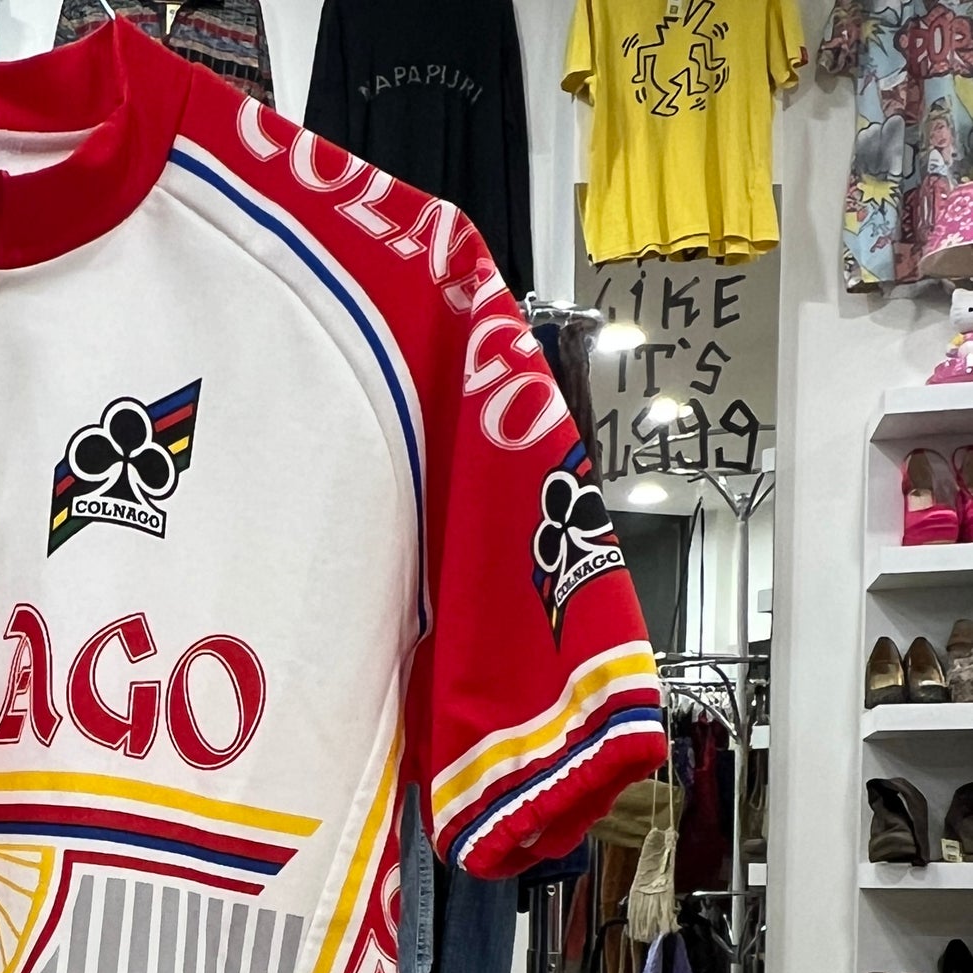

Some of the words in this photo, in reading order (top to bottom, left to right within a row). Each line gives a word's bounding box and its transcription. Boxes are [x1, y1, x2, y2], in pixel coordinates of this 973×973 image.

[595, 398, 760, 482] 1999
[75, 500, 160, 529] COLNAGO
[556, 550, 621, 600] COLNAGO
